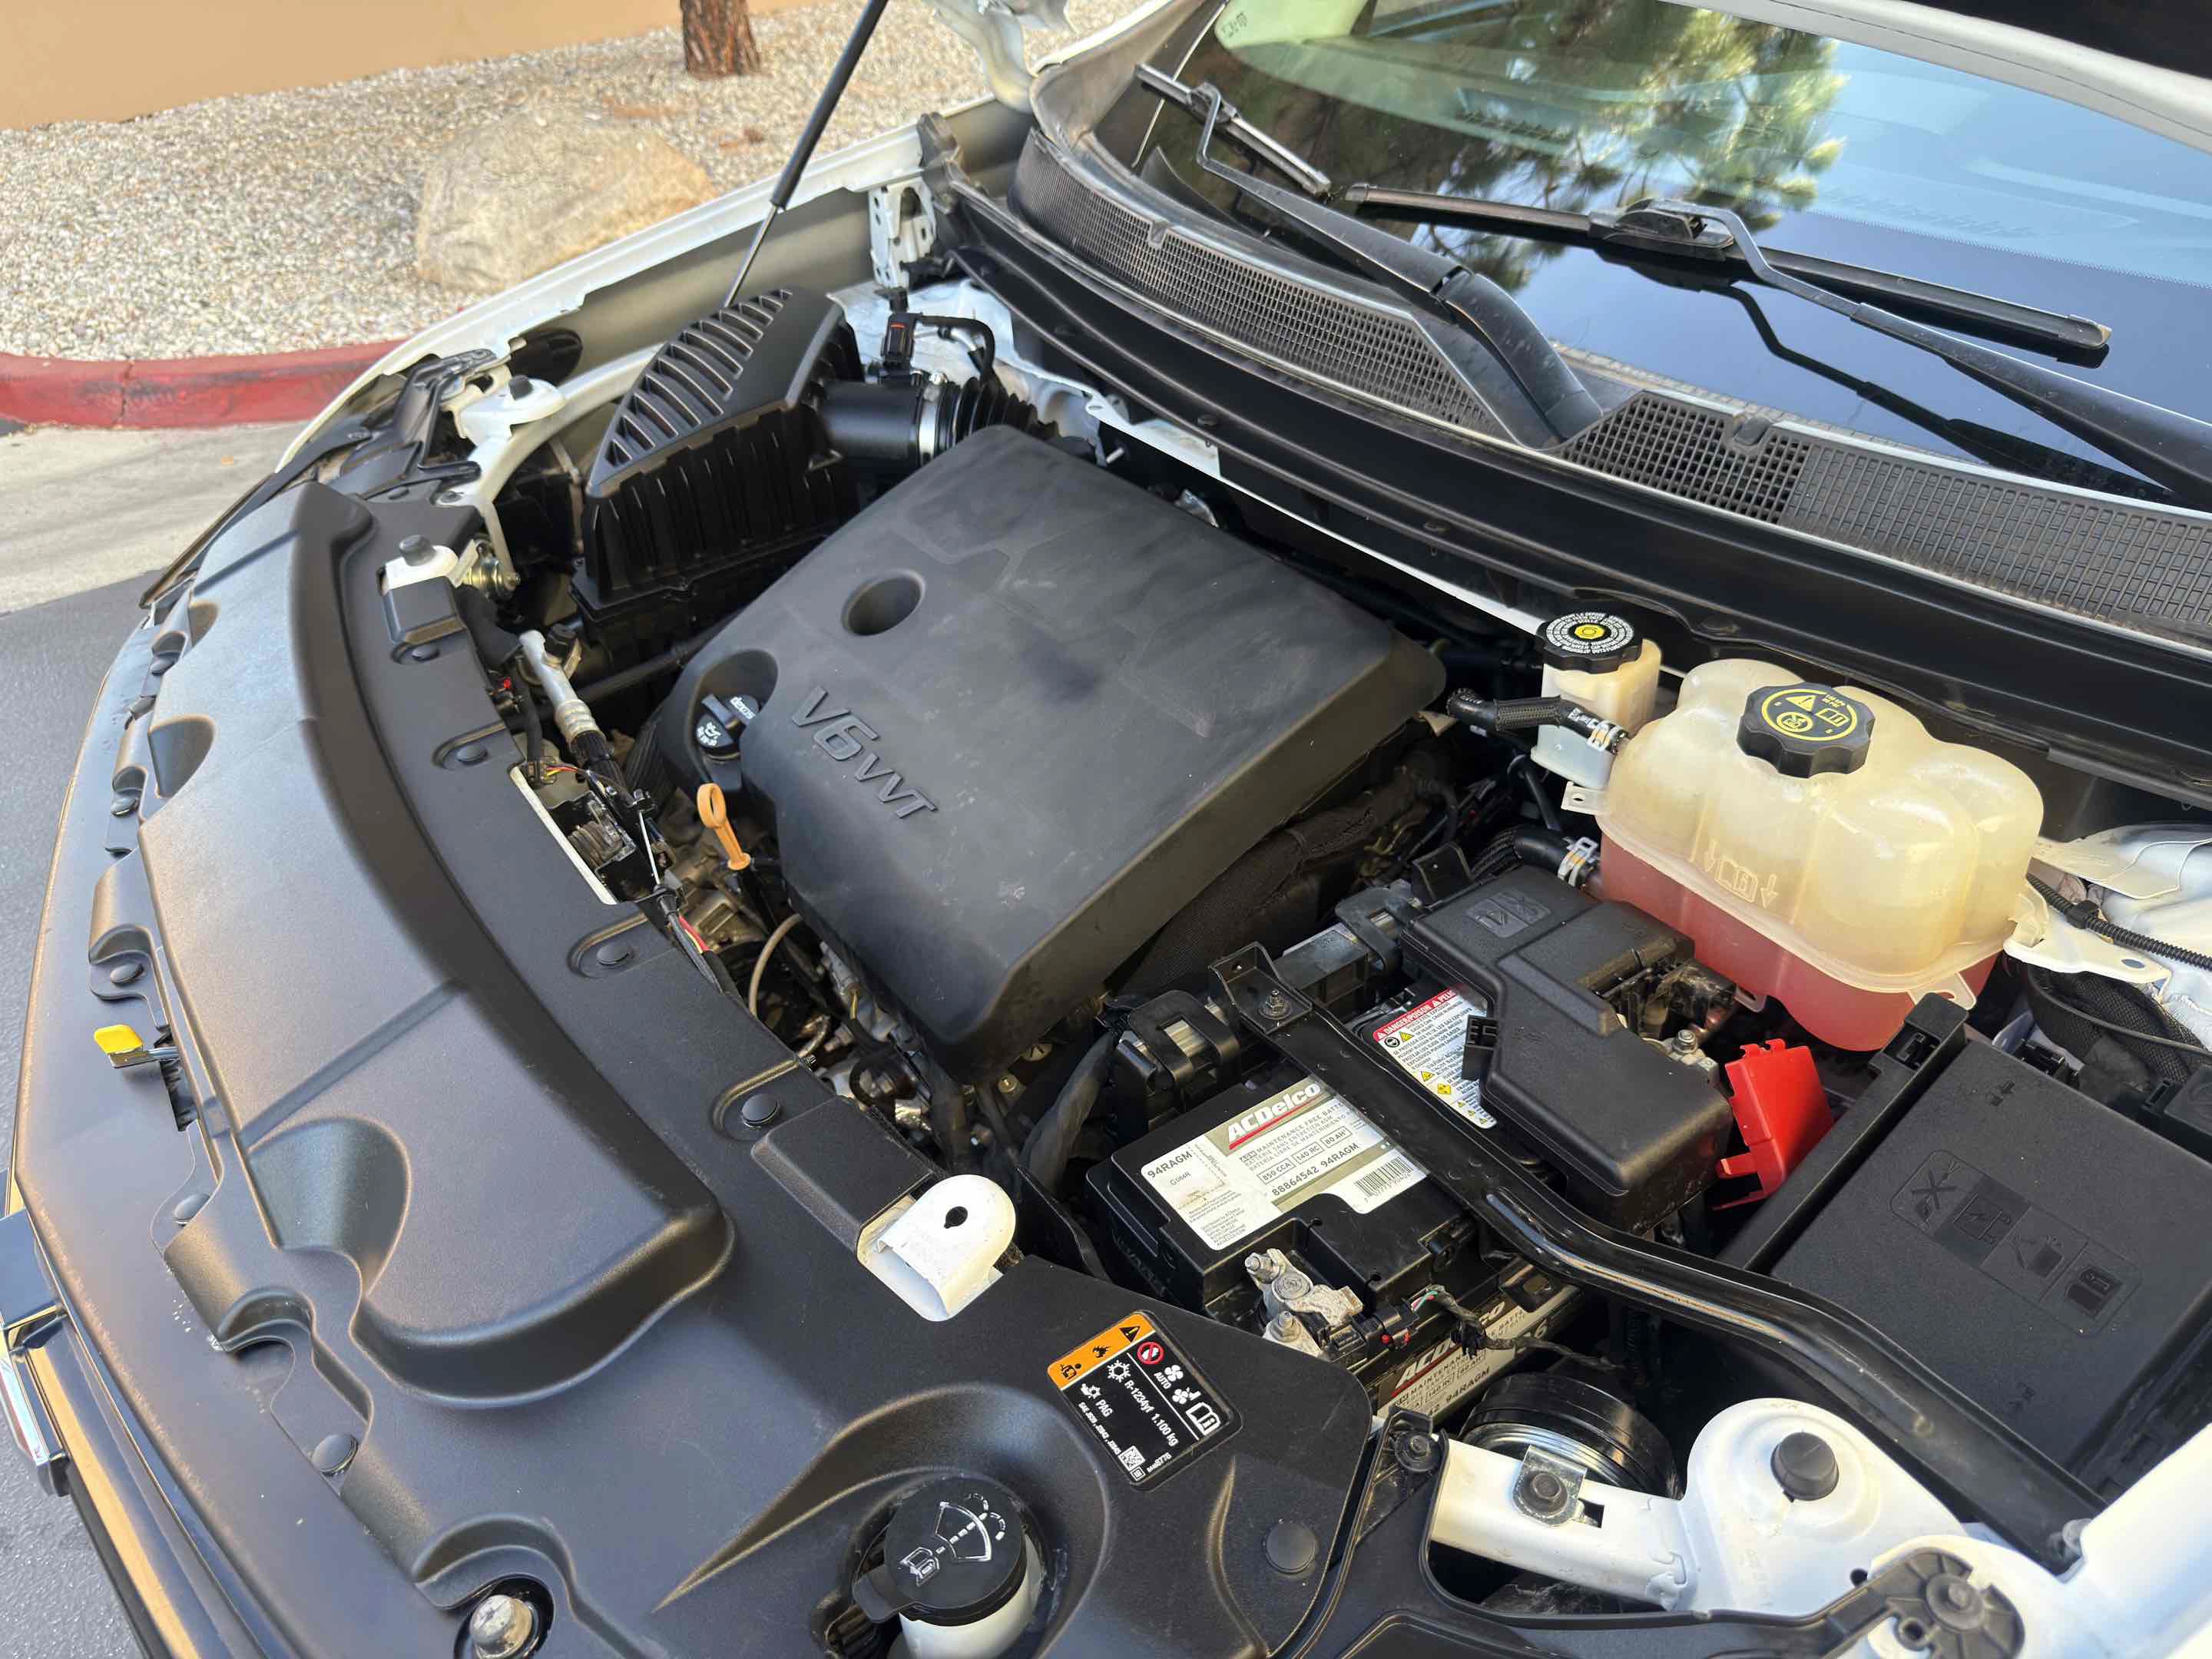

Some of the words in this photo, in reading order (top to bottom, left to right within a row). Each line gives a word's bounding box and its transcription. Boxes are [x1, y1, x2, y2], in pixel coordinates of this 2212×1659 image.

[791, 685, 879, 761] V6
[854, 753, 938, 820] VVT
[1438, 990, 1456, 1003] PELI
[1227, 1083, 1321, 1144] ACDelco
[1257, 1124, 1304, 1153] MAINTENANCE
[1305, 1112, 1322, 1125] FREE
[1273, 1141, 1289, 1151] SANS
[1296, 1151, 1310, 1161] 140
[1147, 1151, 1193, 1179] 94RAGM
[1263, 1170, 1277, 1181] 850
[1277, 1162, 1291, 1172] CCA
[1271, 1166, 1320, 1197] 88864542
[1320, 1142, 1360, 1168] 94RAGM
[1154, 1372, 1172, 1389] AUTO
[1411, 1354, 1462, 1395] MAINTENAN
[1078, 1402, 1090, 1412] SAE
[1095, 1399, 1114, 1418] PAG
[1124, 1379, 1156, 1413] R-1234yf
[1151, 1412, 1171, 1435] 1.100
[1167, 1432, 1180, 1447] kg
